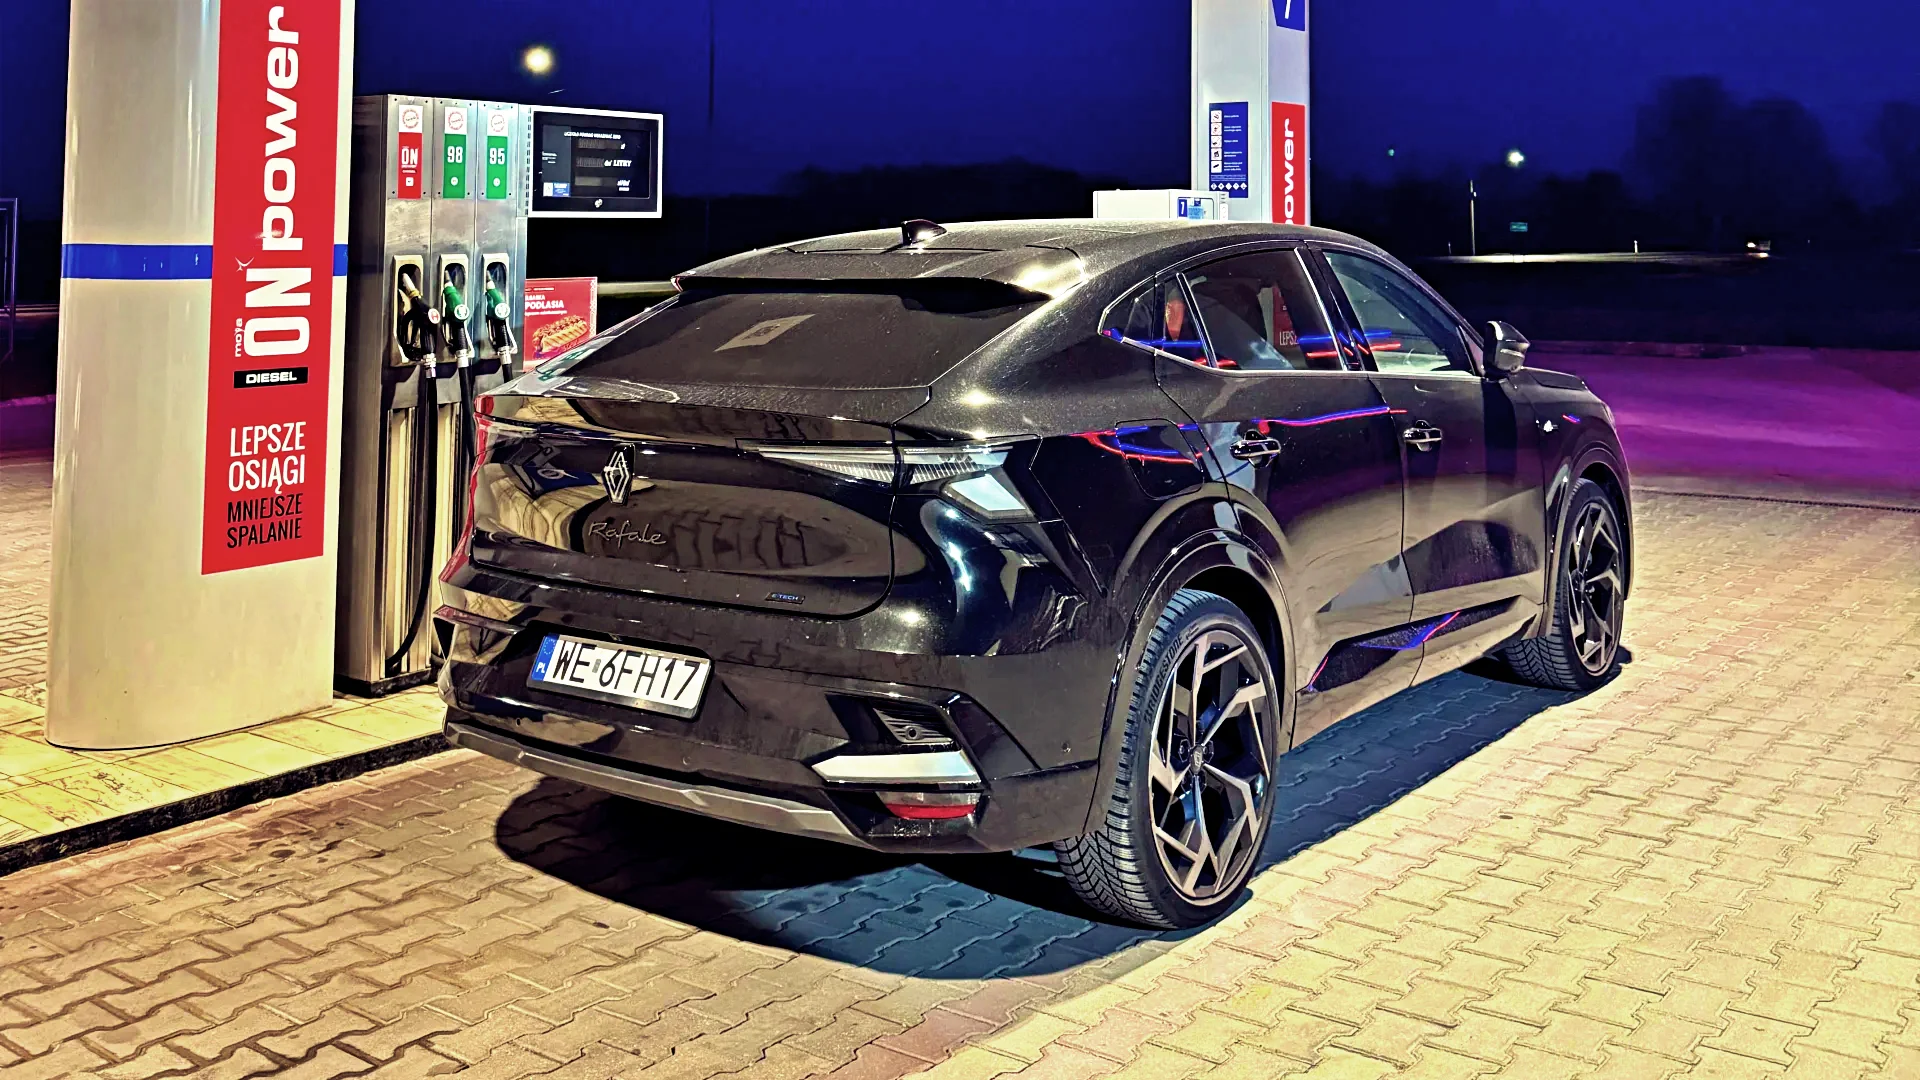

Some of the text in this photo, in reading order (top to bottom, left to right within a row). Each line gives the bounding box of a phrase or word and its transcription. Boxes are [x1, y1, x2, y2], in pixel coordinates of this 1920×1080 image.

[401, 148, 418, 165] ON
[447, 145, 463, 163] 98
[489, 147, 506, 165] 95
[243, 6, 312, 357] ON power
[1284, 118, 1294, 224] ower
[245, 371, 298, 384] DIESEL
[230, 421, 307, 457] LEPSZE
[228, 454, 306, 495] OSIĄGI
[227, 492, 304, 524] MNIEJSZE
[226, 517, 303, 549] SPALANIE
[591, 519, 667, 549] Rafale
[536, 661, 546, 674] PL
[552, 640, 701, 701] WE 6FH17
